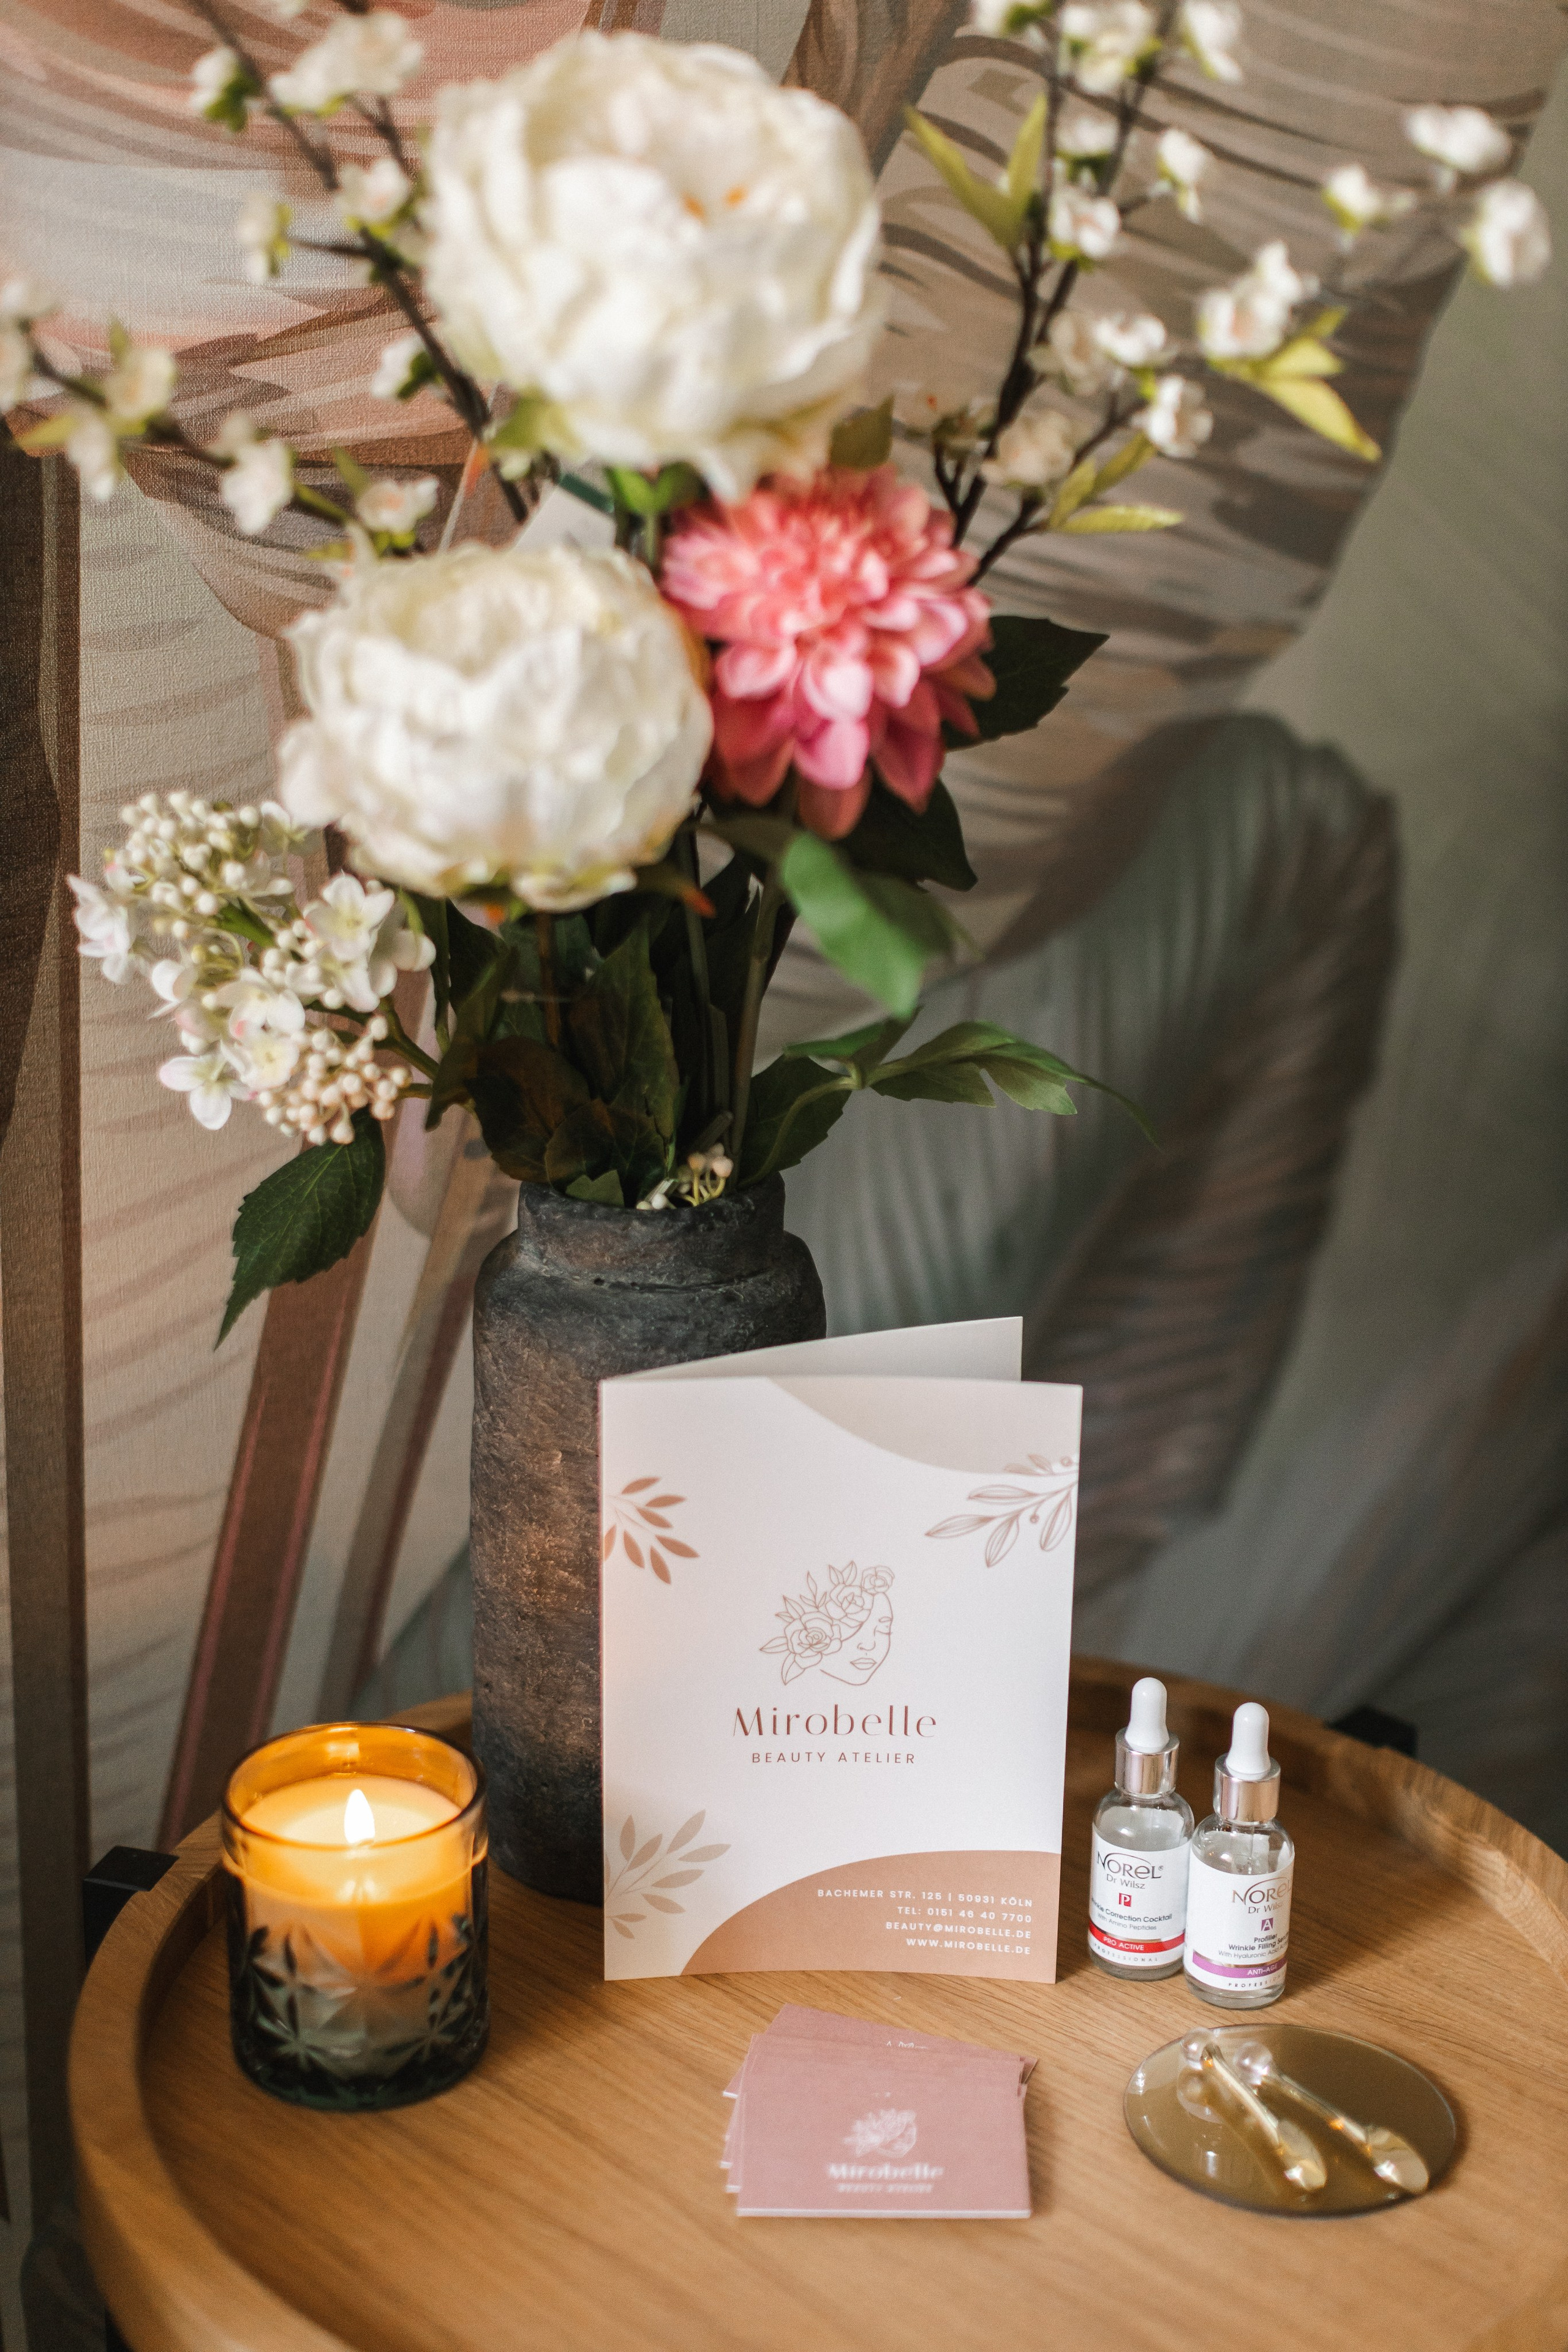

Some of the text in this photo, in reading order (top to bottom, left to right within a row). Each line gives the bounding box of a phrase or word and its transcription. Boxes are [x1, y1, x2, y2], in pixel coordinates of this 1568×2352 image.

[733, 1704, 937, 1737] Mirobelle
[752, 1752, 915, 1764] BEAUTY ATELIER
[1106, 1873, 1146, 1890] Dr Wilsz
[817, 1889, 884, 1898] BACHEMER
[890, 1890, 916, 1899] STR.
[922, 1891, 942, 1900] 125
[959, 1894, 995, 1904] 50931
[1001, 1896, 1032, 1907] KÖLN
[897, 1906, 921, 1915] TEL:
[927, 1907, 952, 1917] 0151
[981, 1911, 995, 1920] 40
[1001, 1913, 1032, 1923] 7700
[1105, 1909, 1142, 1922] Correction
[1143, 1913, 1173, 1922] Cocktail
[886, 1921, 1031, 1939] BEAUTY@MIROBELLE.DE
[1109, 1918, 1128, 1929] Amino
[1262, 1918, 1273, 1931] A
[906, 1938, 1031, 1954] WWW.MIROBELLE.DE
[1103, 1936, 1144, 1951] PRO ACTIVE
